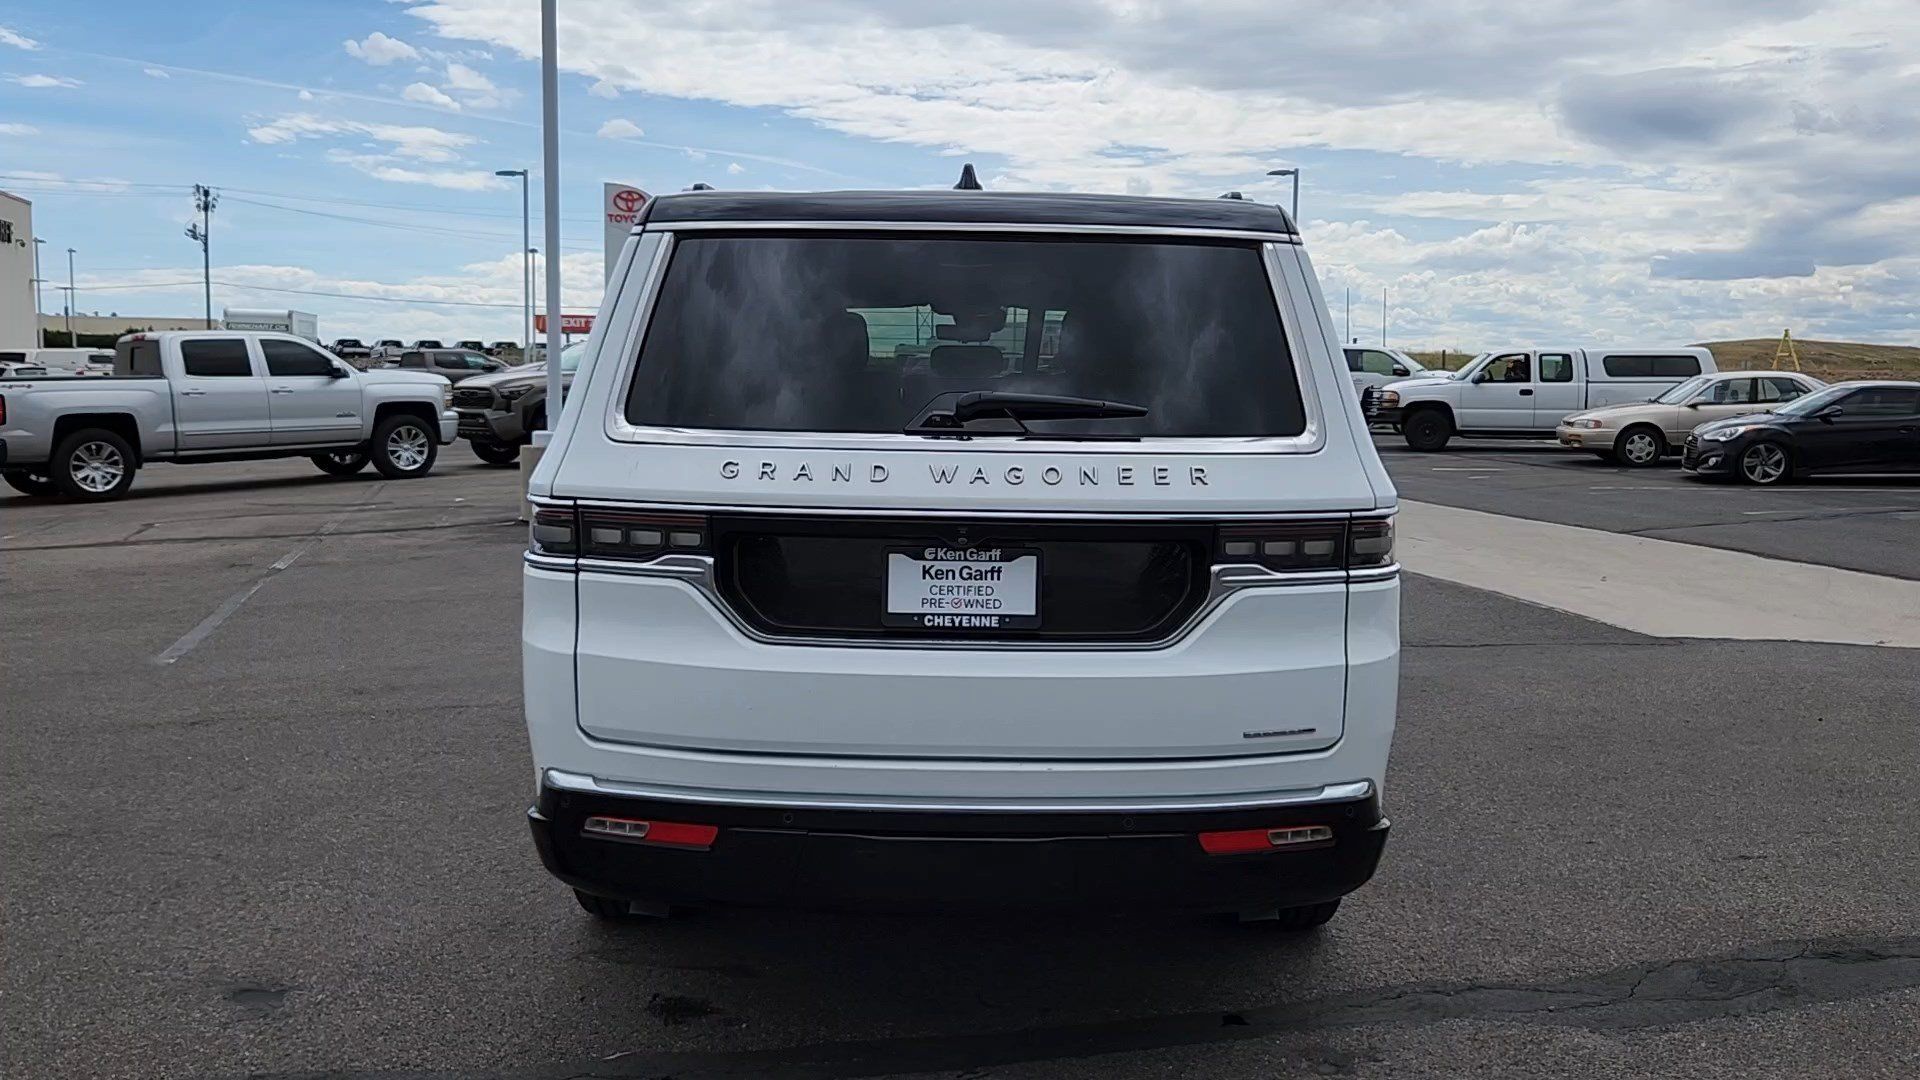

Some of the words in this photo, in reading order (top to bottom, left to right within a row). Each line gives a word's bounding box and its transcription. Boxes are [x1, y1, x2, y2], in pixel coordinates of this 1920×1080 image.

[562, 317, 586, 328] EXIT
[720, 460, 890, 483] GRAND
[928, 463, 1209, 486] WAGONEER
[937, 547, 965, 560] Ken
[966, 548, 1002, 561] Garff
[922, 564, 956, 581] Ken
[959, 565, 1003, 581] Garff
[929, 585, 995, 597] CERTIFIED
[921, 597, 1003, 610] PRE-OWNED
[924, 615, 1000, 627] CHEYENNE
